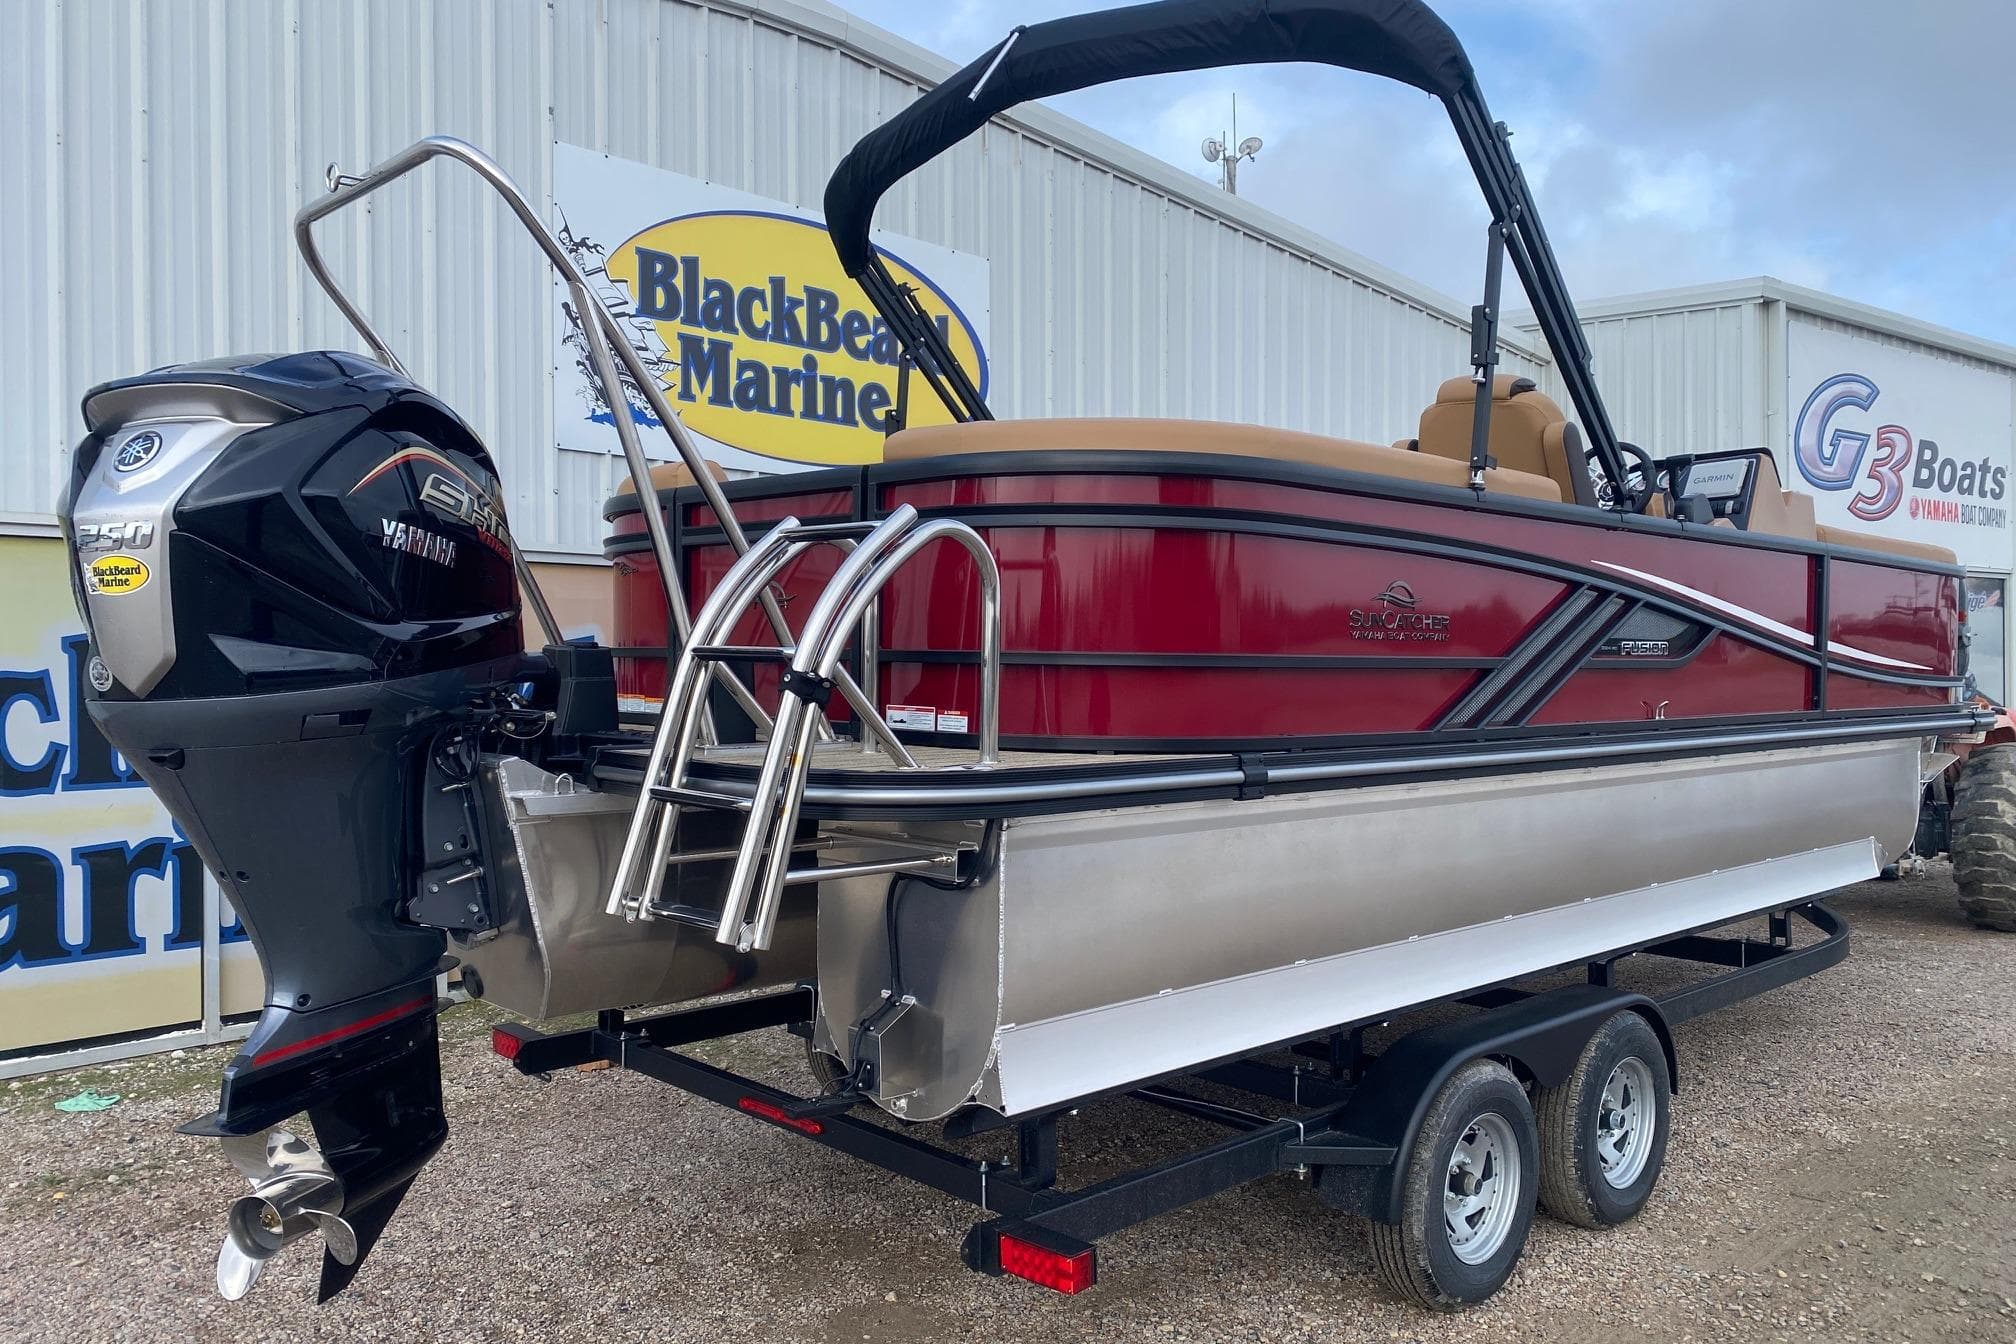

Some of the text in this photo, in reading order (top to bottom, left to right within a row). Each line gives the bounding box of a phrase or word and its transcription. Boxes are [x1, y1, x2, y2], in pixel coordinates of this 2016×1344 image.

[635, 246, 949, 377] BlackBea
[676, 332, 892, 432] Marine
[1794, 373, 2006, 521] G3 Boats
[1693, 472, 1736, 484] GARMIN
[1921, 498, 2006, 528] YAMAHA BOAT COMPANY
[79, 521, 154, 552] 250
[381, 518, 456, 568] YAMAHA
[92, 564, 141, 577] BlackBeard
[98, 577, 131, 588] Marine
[1350, 630, 1384, 640] YAMAHA
